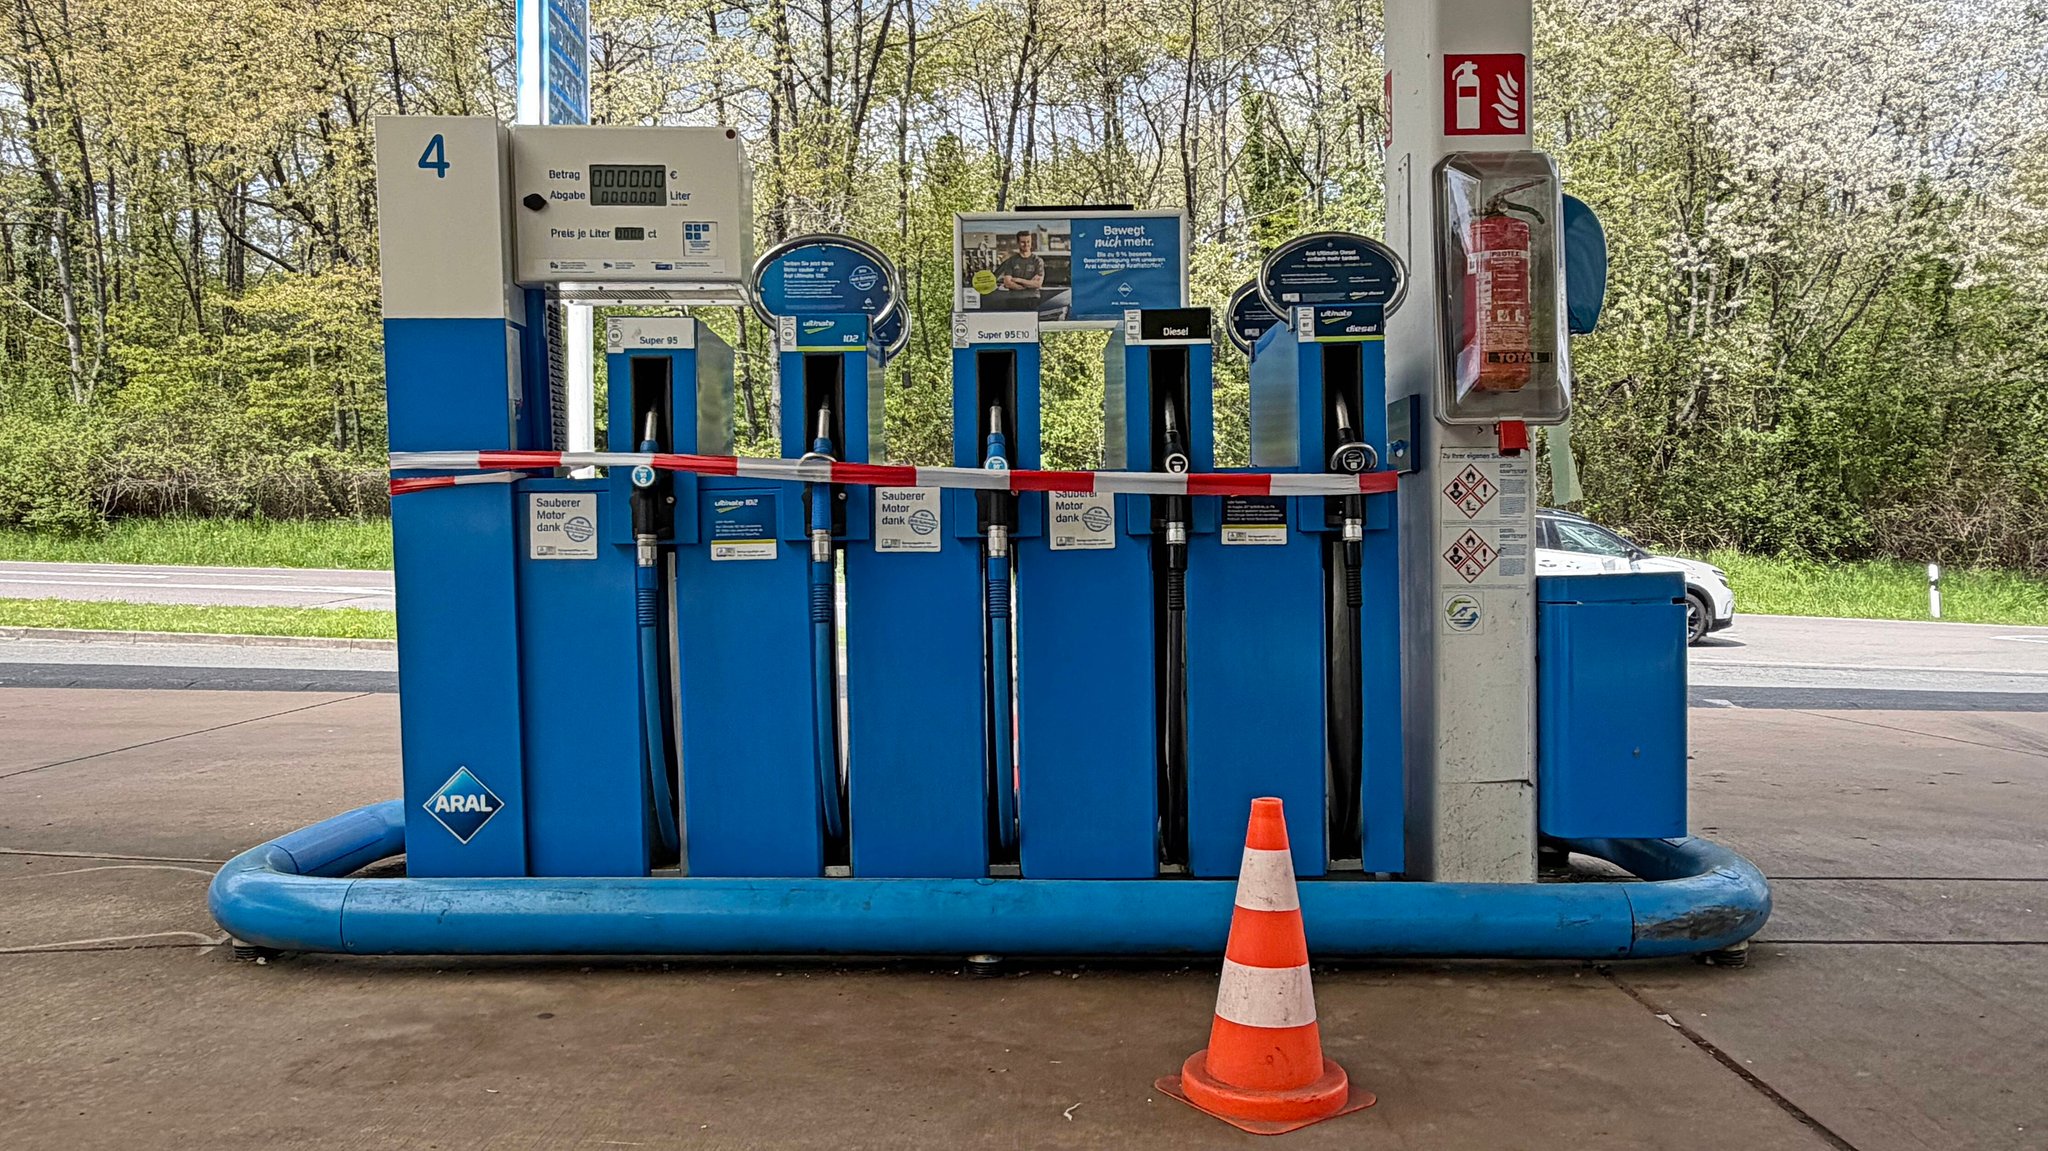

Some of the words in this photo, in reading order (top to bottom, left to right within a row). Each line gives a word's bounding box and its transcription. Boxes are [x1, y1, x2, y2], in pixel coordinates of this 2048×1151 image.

[418, 134, 450, 178] 4
[549, 170, 580, 181] Betrag
[670, 171, 678, 179] €
[550, 191, 585, 201] Abgabe
[670, 191, 691, 200] Liter
[551, 229, 575, 238] Preis
[577, 228, 586, 240] je
[589, 229, 611, 238] Liter
[648, 229, 657, 238] ct
[1103, 225, 1145, 237] Bewegt
[1095, 236, 1122, 248] mich
[1124, 237, 1154, 247] mehr.
[1163, 327, 1189, 336] Diesel
[1346, 324, 1377, 332] diesel
[843, 334, 859, 342] 102
[978, 331, 1002, 340] Super
[639, 336, 664, 346] Super
[667, 336, 678, 344] 95
[1498, 352, 1540, 363] TOTAL
[882, 491, 925, 501] Sauberer
[536, 498, 581, 507] Sauberer
[1056, 501, 1084, 510] Motor
[882, 504, 910, 513] Motor
[537, 510, 566, 519] Motor
[1056, 513, 1079, 523] dank
[882, 516, 905, 525] dank
[537, 522, 561, 532] dank
[434, 794, 493, 813] ARAL
